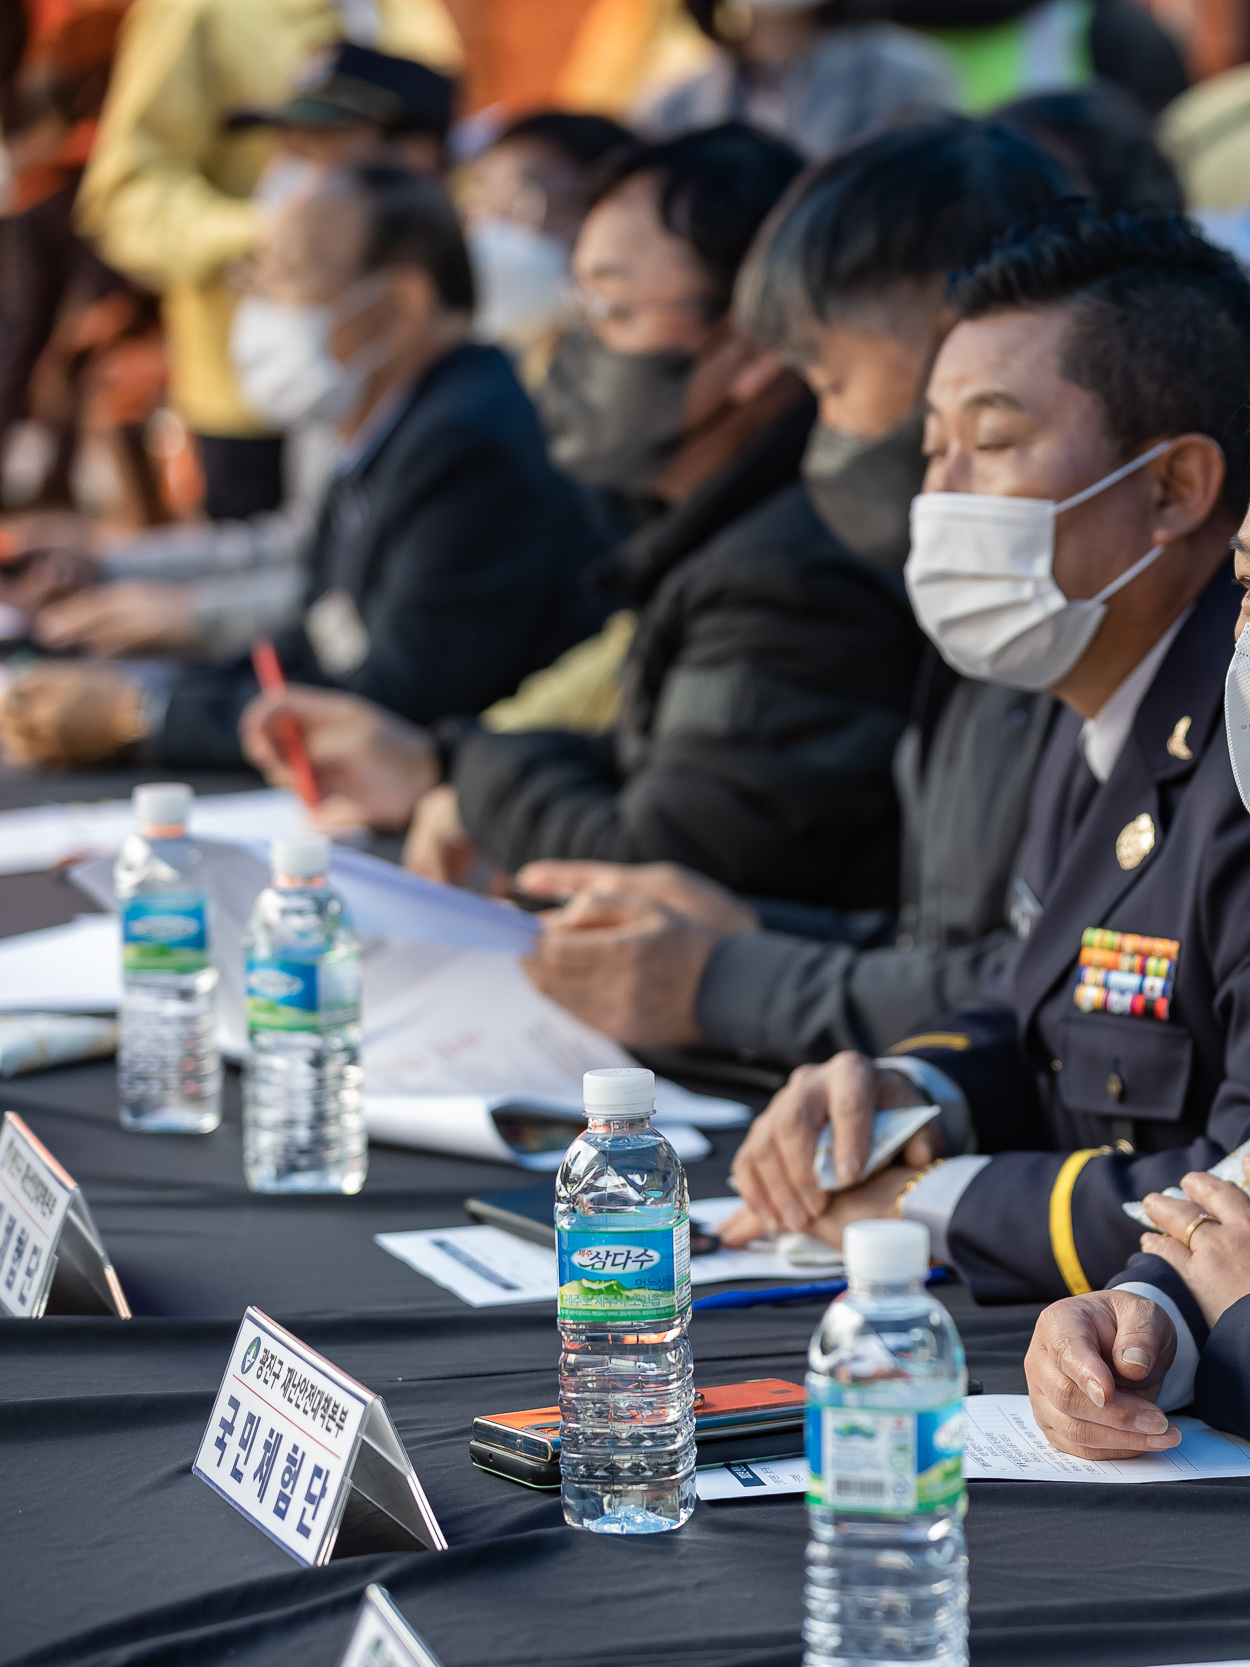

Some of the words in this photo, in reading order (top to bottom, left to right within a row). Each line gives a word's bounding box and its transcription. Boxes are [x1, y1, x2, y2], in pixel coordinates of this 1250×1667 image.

[577, 1249, 593, 1259] 제주
[588, 1248, 655, 1271] 삼다수
[255, 1348, 284, 1390] 광진구
[280, 1366, 350, 1438] 재난안전대책본부
[213, 1394, 330, 1540] 국민체험단
